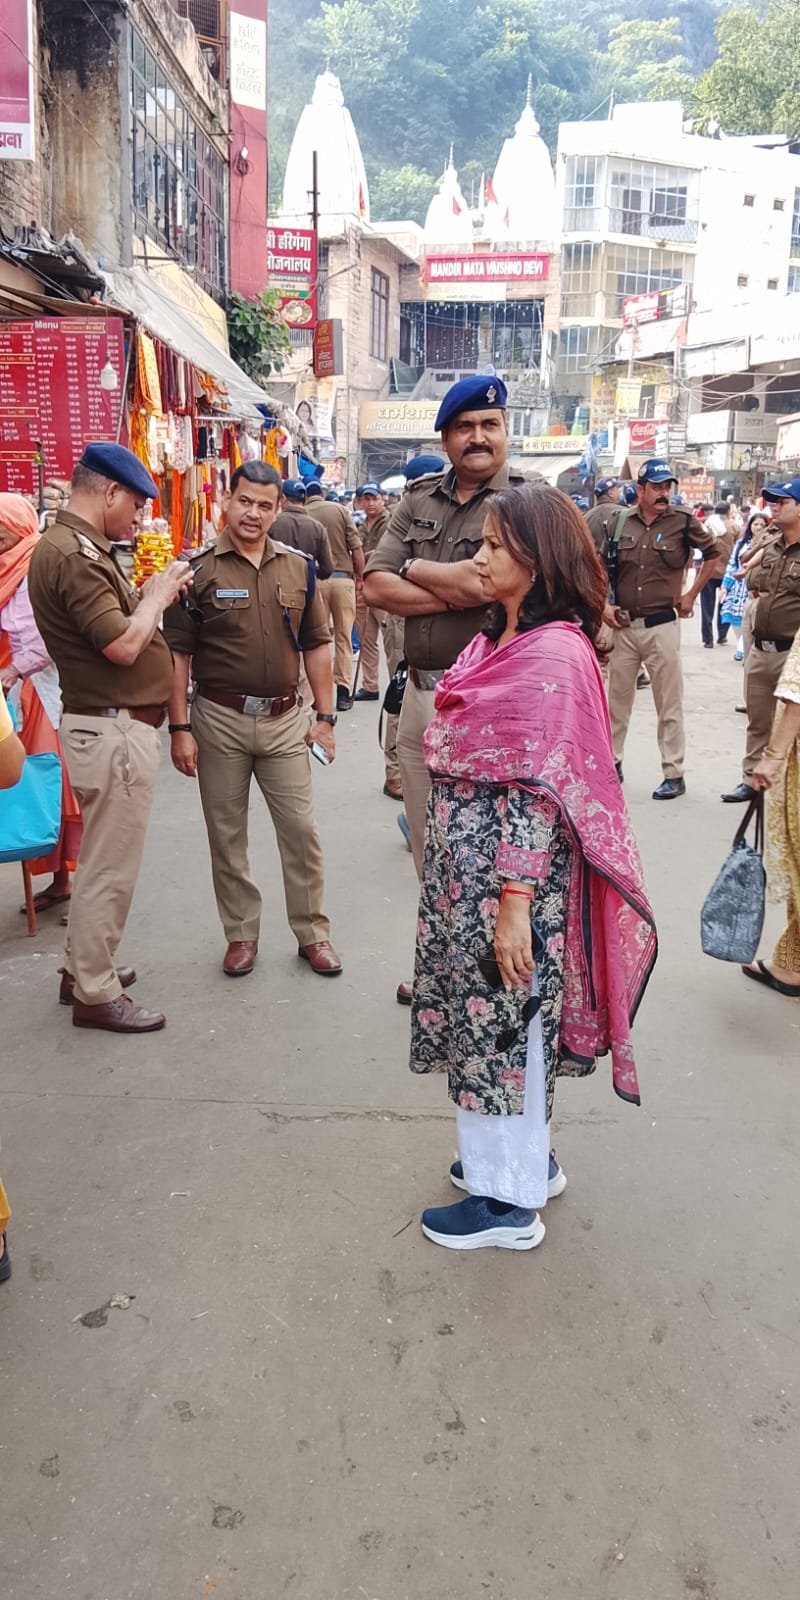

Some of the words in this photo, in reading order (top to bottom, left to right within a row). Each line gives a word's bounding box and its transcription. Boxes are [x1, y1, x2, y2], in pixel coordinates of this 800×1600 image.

[430, 261, 462, 278] MANDIR
[462, 261, 485, 276] MATA
[485, 260, 522, 276] VAISHNO
[523, 260, 544, 275] DEVI
[34, 320, 59, 330] Menu
[375, 403, 438, 420] धर्मशाल
